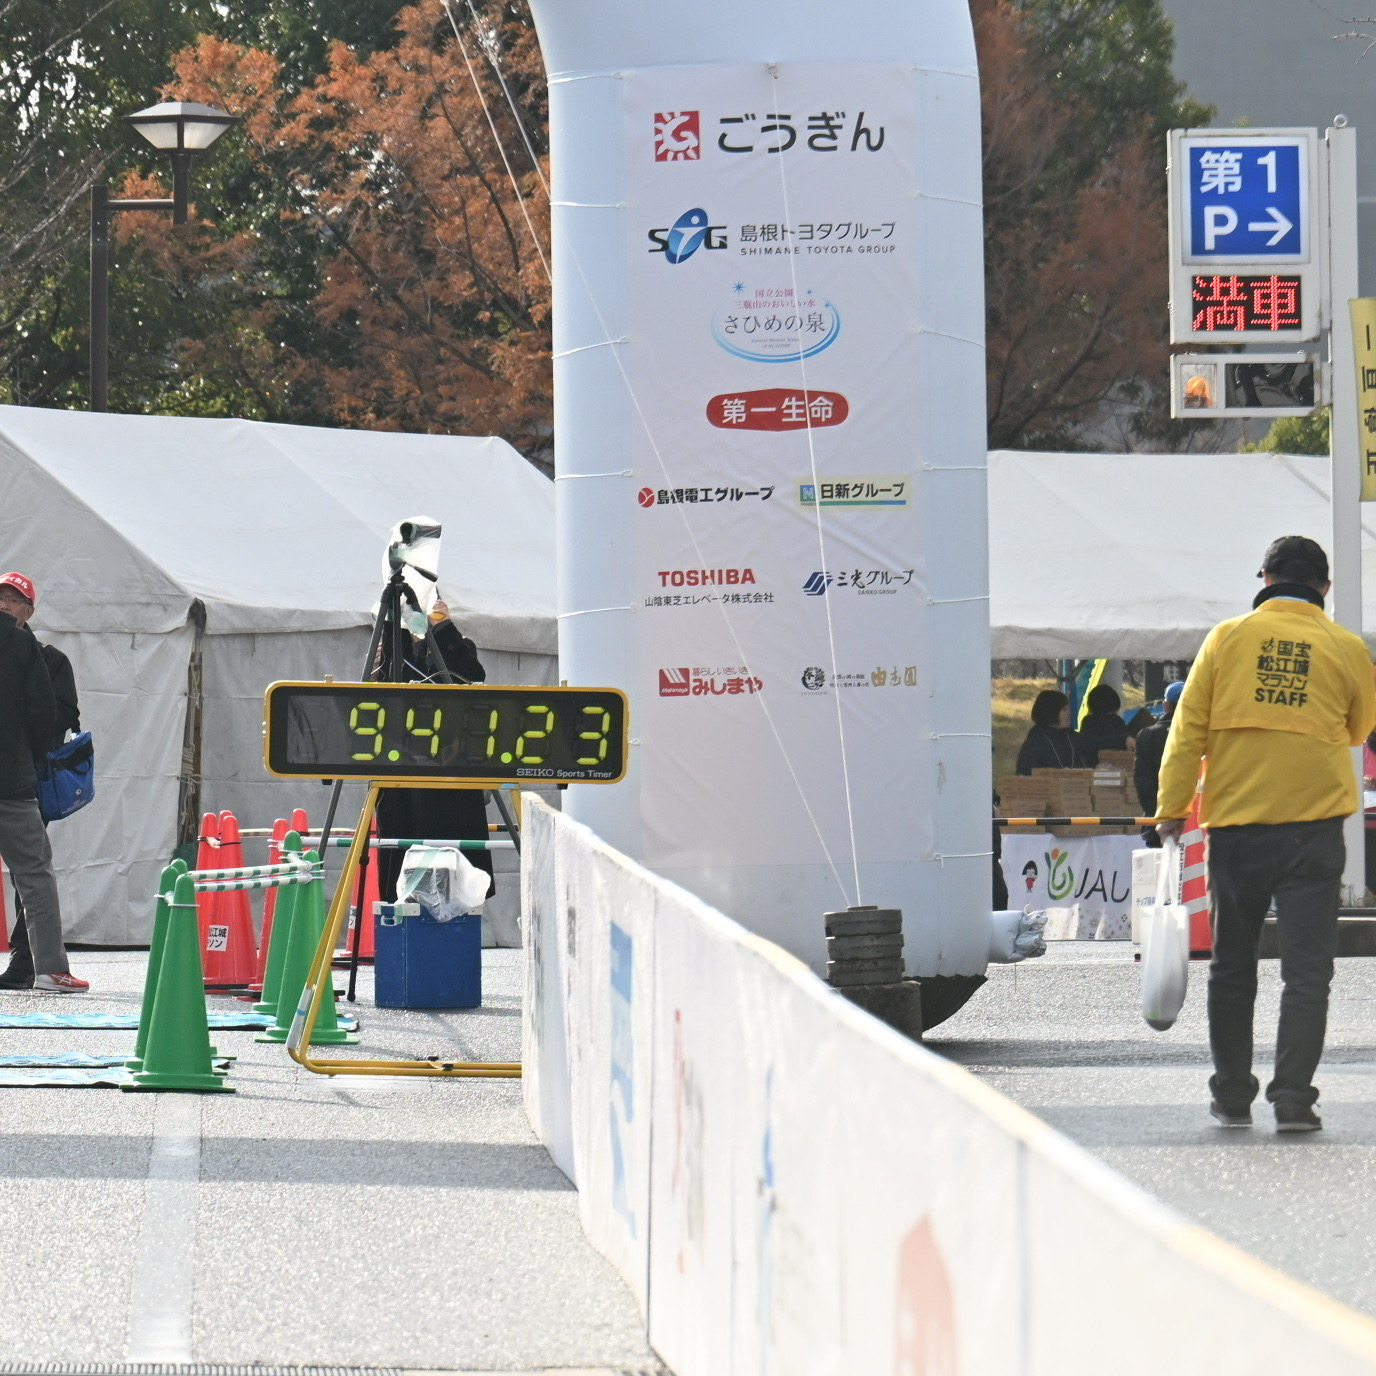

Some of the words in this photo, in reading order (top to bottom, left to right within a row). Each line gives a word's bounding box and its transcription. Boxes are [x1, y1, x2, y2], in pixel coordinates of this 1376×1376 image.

[717, 111, 884, 154] ごうぎん
[740, 221, 896, 243] 島根トヨタグループ
[1204, 205, 1239, 251] P
[740, 246, 800, 256] SHIMANE
[807, 246, 853, 254] TOYOTA
[858, 245, 896, 254] GROUP
[1192, 275, 1299, 331] 満車
[721, 395, 833, 424] 第一生命
[657, 485, 775, 505] 島根電工グループ
[820, 482, 906, 500] 日新グループ
[657, 568, 756, 588] TOSHIBA
[836, 569, 915, 589] 三光グループ
[691, 677, 763, 696] みしまや
[1256, 672, 1308, 691] マラソン
[1254, 687, 1308, 708] STAFF
[516, 768, 554, 777] SEIKO
[556, 769, 585, 779] Sports
[587, 769, 612, 778] Timer
